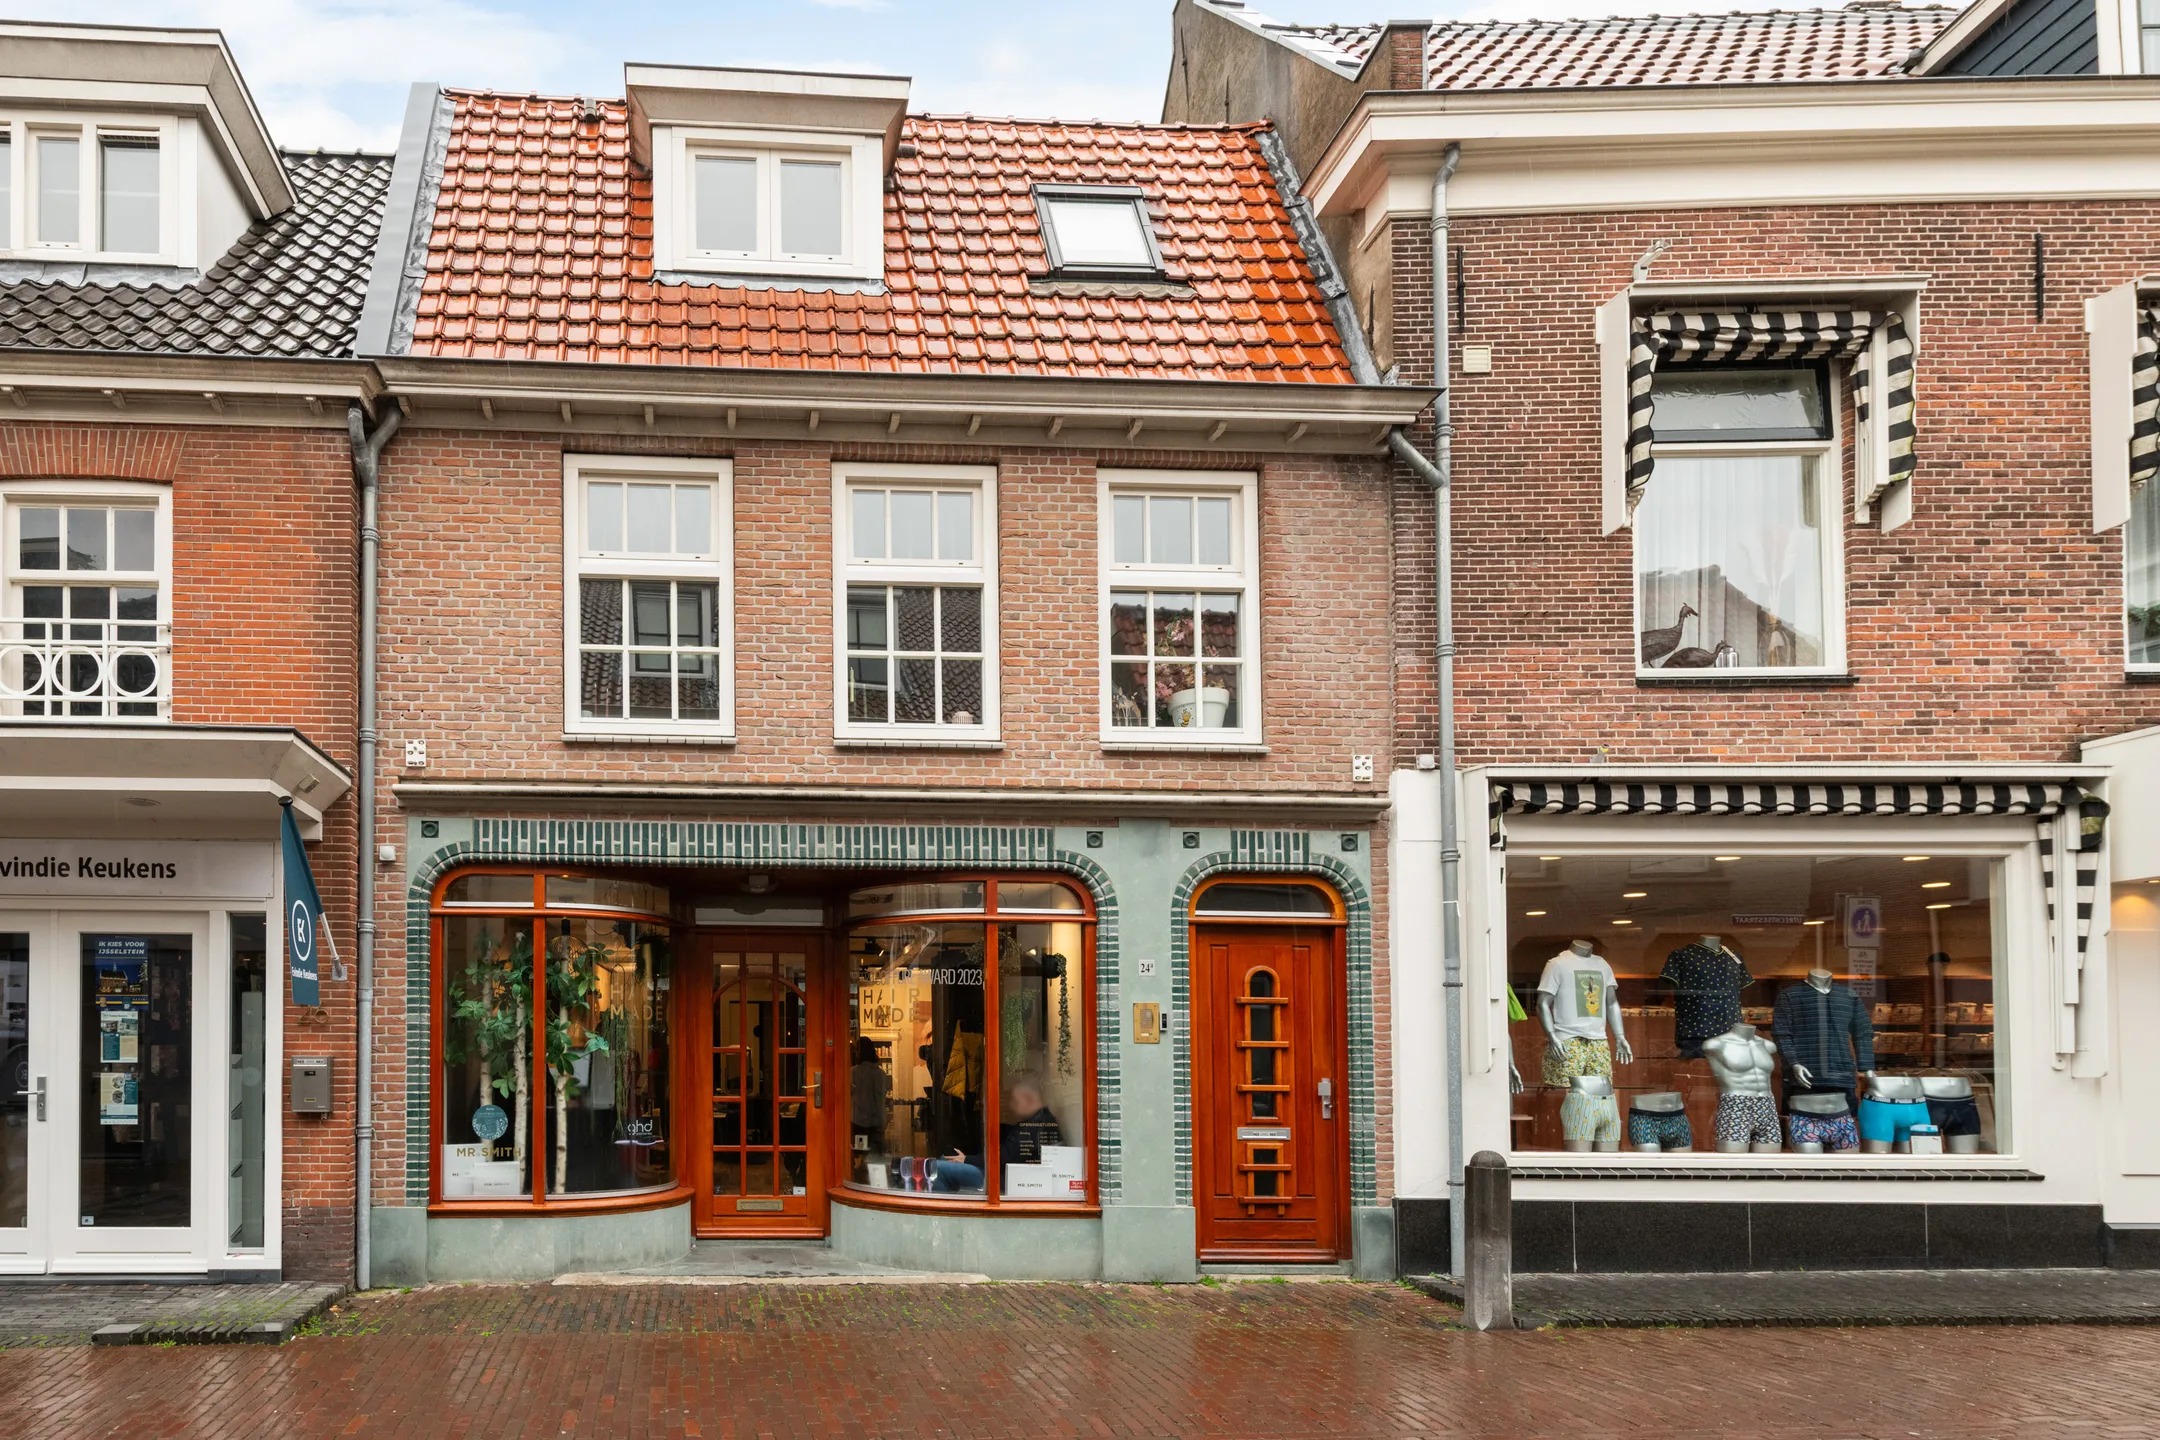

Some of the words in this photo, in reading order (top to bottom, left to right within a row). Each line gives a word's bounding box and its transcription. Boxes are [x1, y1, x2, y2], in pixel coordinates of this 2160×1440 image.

[78, 857, 176, 878] Keukens
[957, 968, 983, 985] 2023
[628, 1120, 653, 1135] ghd
[482, 1147, 521, 1157] SMITH
